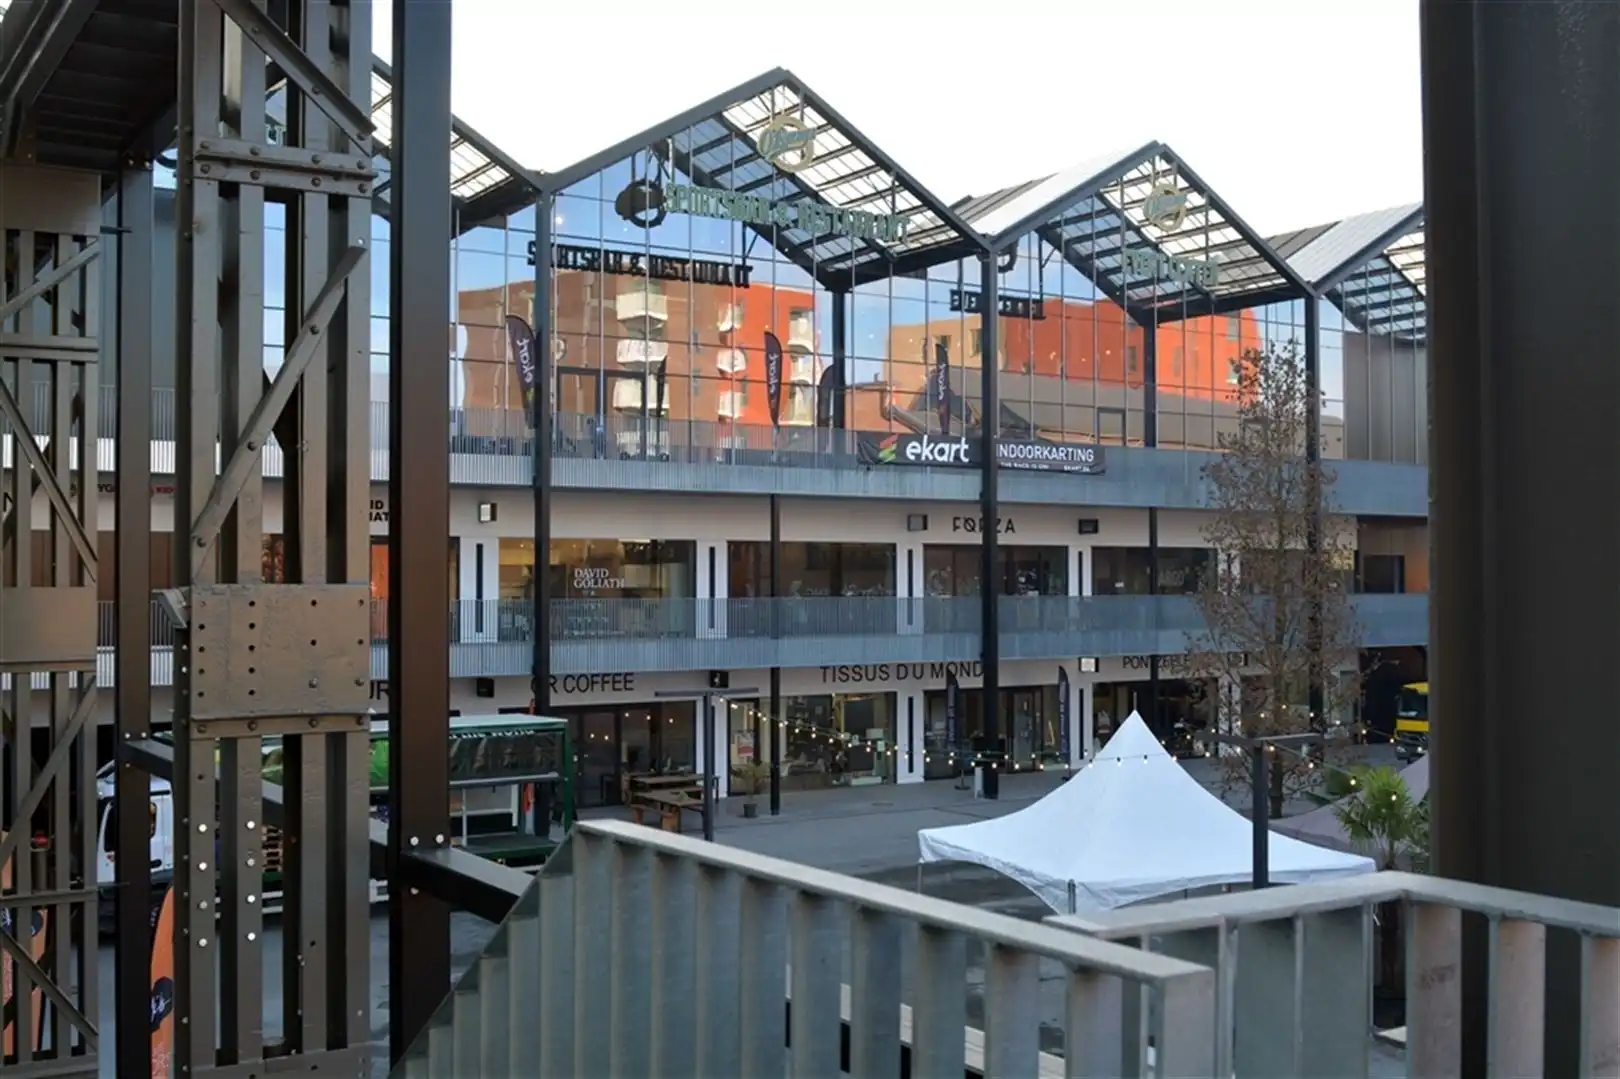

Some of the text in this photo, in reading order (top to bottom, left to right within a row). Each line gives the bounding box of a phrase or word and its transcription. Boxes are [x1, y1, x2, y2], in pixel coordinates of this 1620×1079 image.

[905, 434, 1095, 463] ekart INDOORKARTING
[573, 578, 625, 589] GOLIATH
[574, 567, 610, 578] DAVID
[562, 672, 635, 694] COFFEE
[819, 660, 985, 684] TISSUS DU MOND
